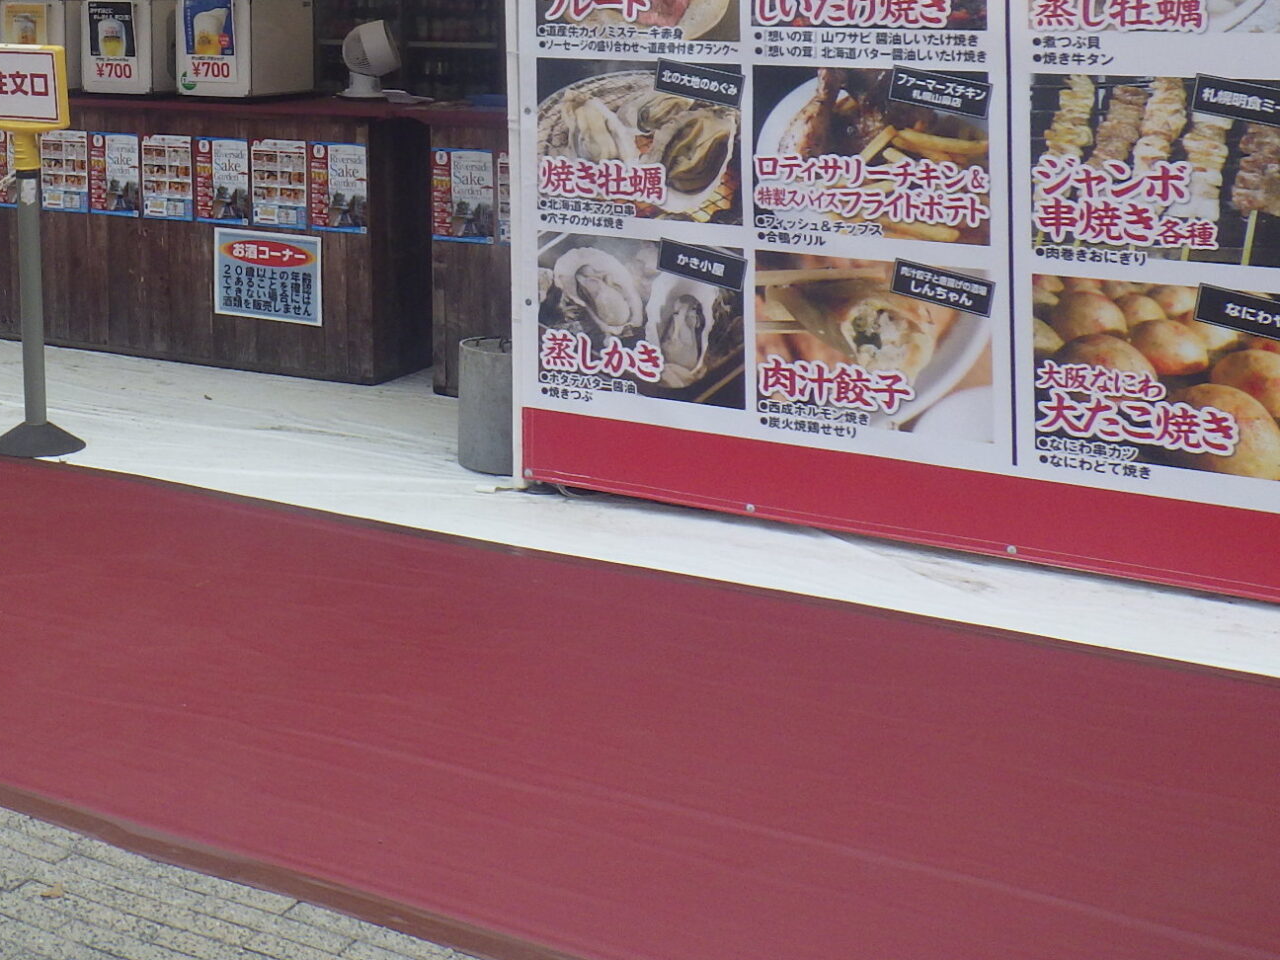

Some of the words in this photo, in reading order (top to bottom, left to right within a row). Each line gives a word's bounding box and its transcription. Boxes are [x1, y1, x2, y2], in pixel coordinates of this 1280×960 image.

[1042, 36, 1101, 49] 煮つぶ貝
[1042, 52, 1114, 65] 焼き牛タン
[96, 63, 132, 79] ¥700
[192, 62, 230, 78] ¥700
[661, 70, 738, 95] 北の大地のめぐみ
[897, 73, 987, 101] ファーマーズチキン
[214, 159, 241, 172] Sake
[330, 164, 360, 178] Sake
[453, 172, 485, 186] Sake
[541, 159, 664, 200] 焼き牡蠣
[1036, 158, 1187, 201] ジャンボ
[547, 200, 635, 216] 北海道本マグロ串
[757, 188, 986, 224] 特製スパイスフライドポテト
[547, 213, 624, 229] 穴子のかば焼き
[232, 243, 306, 261] お酒コーナー
[1045, 248, 1147, 266] 肉巻きおにぎり
[677, 254, 725, 277] かき小屋
[910, 281, 973, 306] しんちゃん
[544, 333, 661, 379] 蒸しかき
[762, 359, 910, 409] 肉汁餃子
[1038, 363, 1165, 399] 大阪なにわ
[549, 388, 593, 401] 焼きつぶ
[768, 402, 869, 426] 西成ホルモン焼き
[1039, 394, 1234, 452] 大たこ焼き
[768, 418, 857, 438] 炭火焼鶏せせり
[1049, 439, 1138, 461] なにわ串カツ
[1050, 455, 1151, 479] なにわどて焼き
